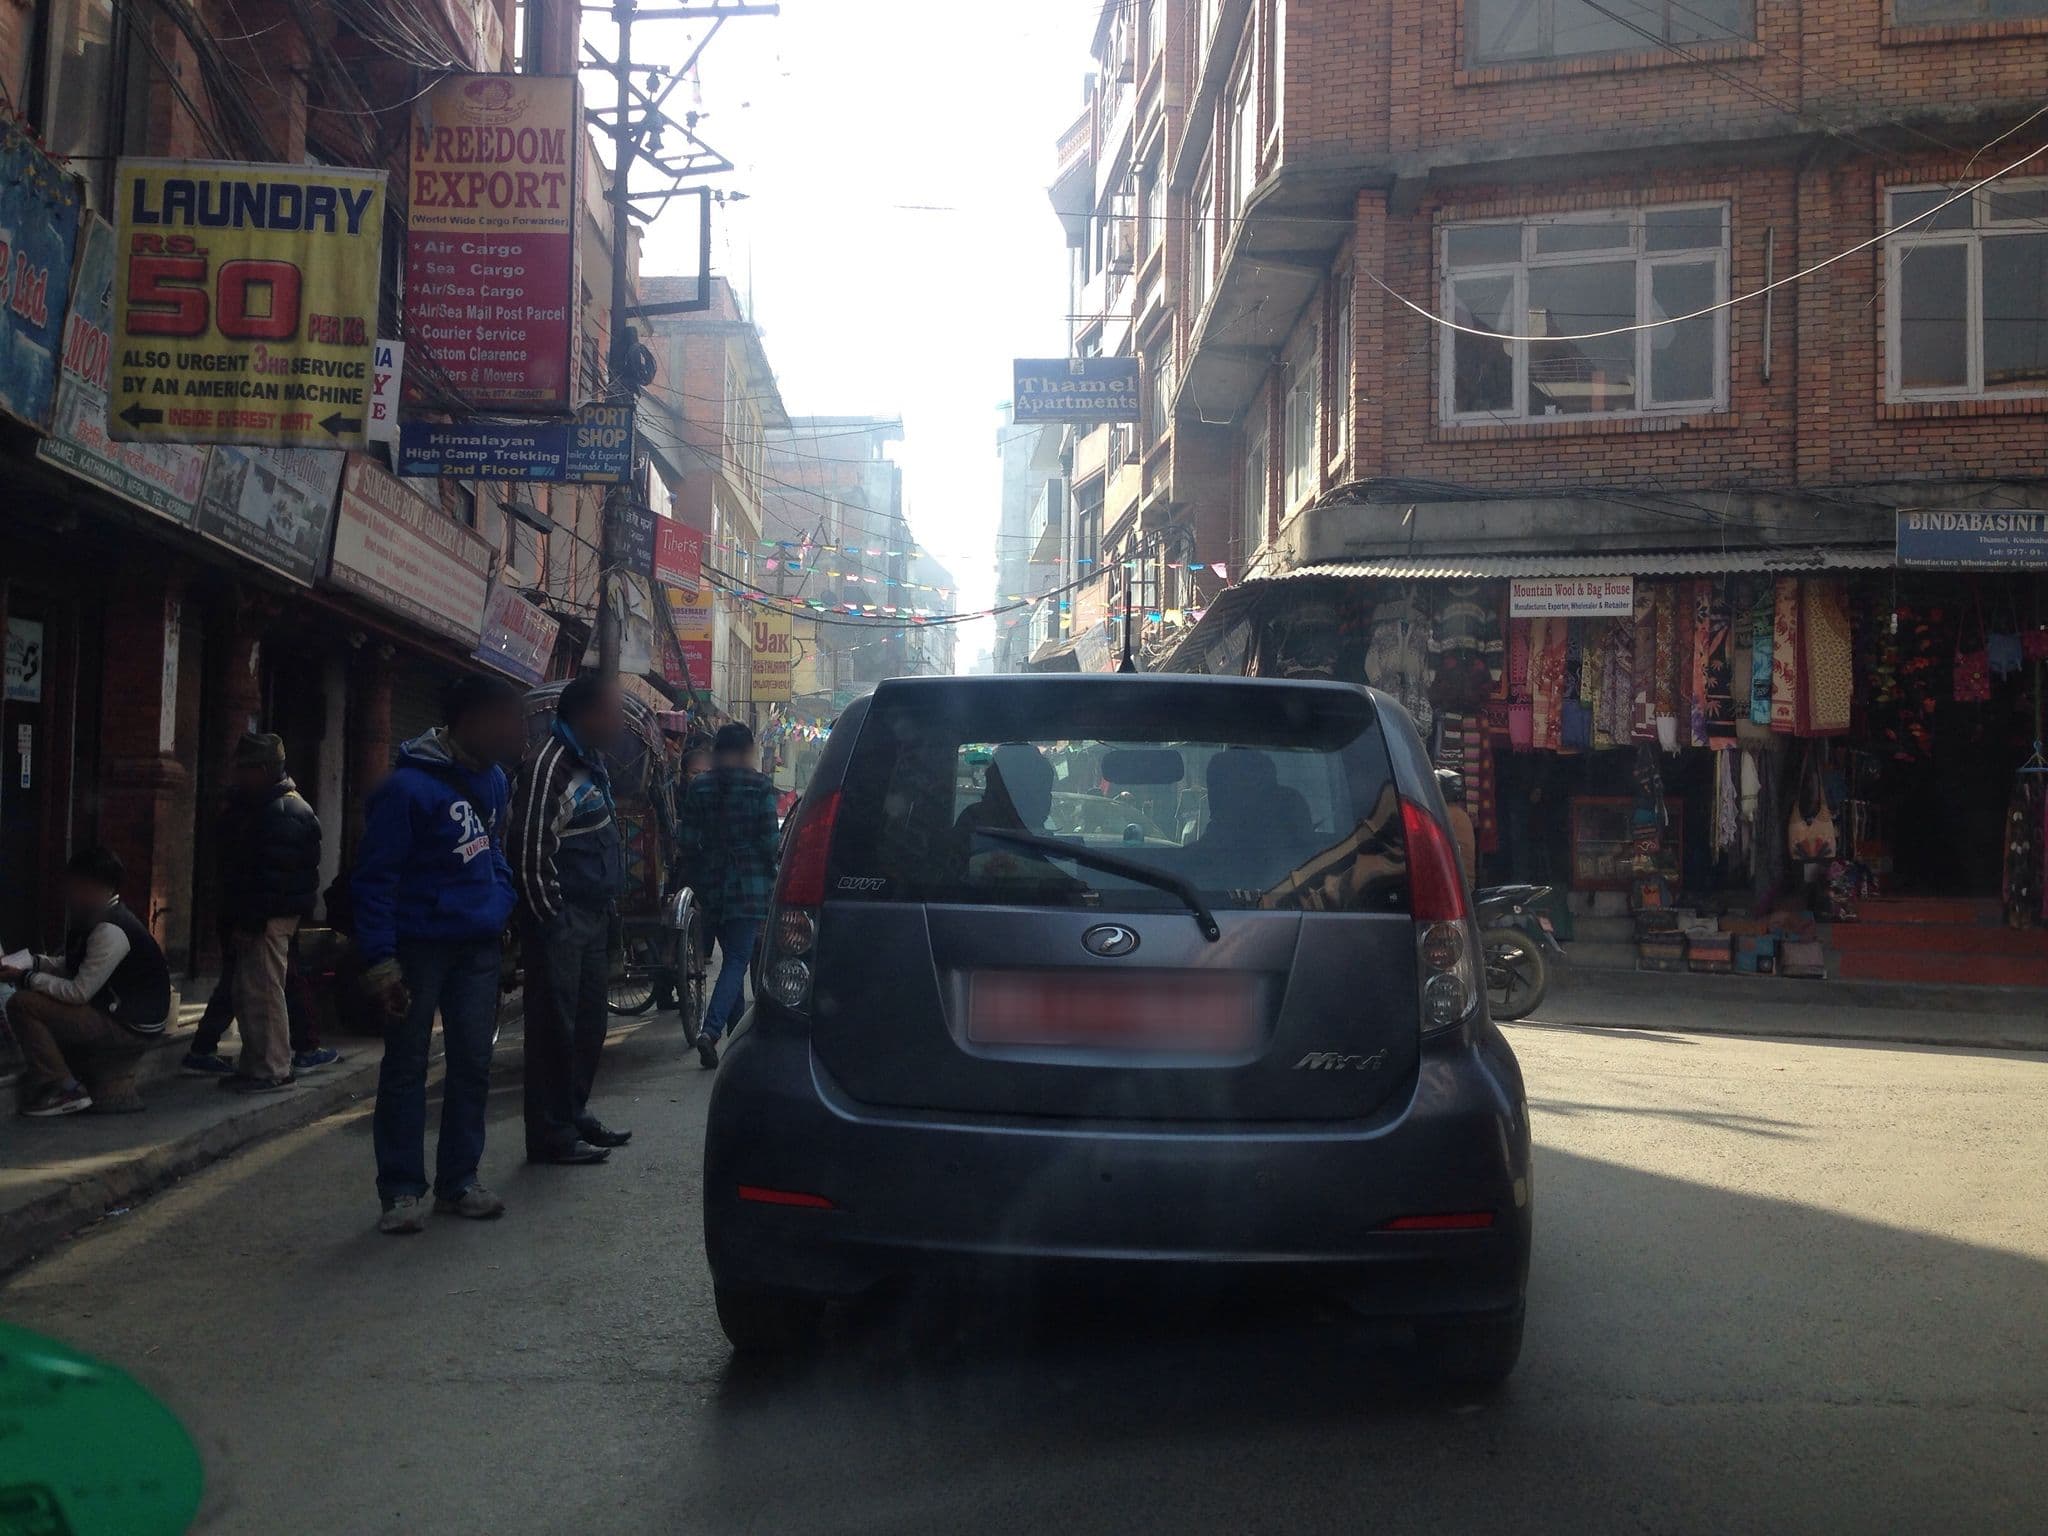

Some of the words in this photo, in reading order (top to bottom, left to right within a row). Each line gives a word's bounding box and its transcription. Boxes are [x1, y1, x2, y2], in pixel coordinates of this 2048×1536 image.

[414, 126, 566, 164] FREEDOM
[414, 171, 566, 208] EXPORT
[132, 178, 373, 236] LAUNDRY
[412, 214, 447, 225] (World
[450, 215, 476, 225] Wide
[479, 216, 510, 227] Cargo
[424, 241, 454, 254] Air
[461, 242, 522, 257] Cargo
[426, 263, 456, 274] Sea
[470, 264, 525, 277] Cargo
[126, 254, 302, 342] 50
[421, 283, 475, 297] Air/Sea
[480, 285, 524, 299] Cargo
[466, 305, 492, 320] Mail
[496, 306, 523, 321] Post
[527, 306, 565, 321] Parcel
[308, 313, 341, 344] PER
[422, 324, 472, 339] Courier
[476, 326, 526, 341] Service
[469, 347, 527, 361] Clearence
[123, 351, 171, 369] ALSO
[177, 353, 249, 372] URGENT
[291, 357, 364, 379] SERVICE
[470, 368, 479, 382] &
[483, 368, 525, 382] Movers
[123, 376, 147, 393] BY
[152, 378, 180, 395] AN
[185, 380, 278, 400] AMERICAN
[283, 384, 362, 405] MACHINE
[1018, 377, 1137, 393] Thamel
[1017, 394, 1138, 413] Apartments
[168, 408, 213, 427] INSIDE
[217, 410, 276, 430] EVEREST
[430, 434, 535, 447] Himalayan
[577, 428, 628, 448] SHOP
[406, 449, 440, 460] High
[445, 449, 488, 461] Camp
[494, 449, 560, 464] Trekking
[443, 464, 475, 475] 2nd
[481, 465, 528, 476] Floor
[364, 464, 402, 515] SINGING
[401, 493, 425, 530] BOWL
[425, 510, 458, 552] GALLERY
[1908, 512, 2037, 531] BINDABASINI
[1514, 584, 1552, 597] Mountain
[1555, 583, 1575, 596] Wool
[1577, 583, 1584, 595] &
[1587, 583, 1602, 599] Bag
[1604, 583, 1630, 595] House
[1604, 601, 1630, 609] Retailer
